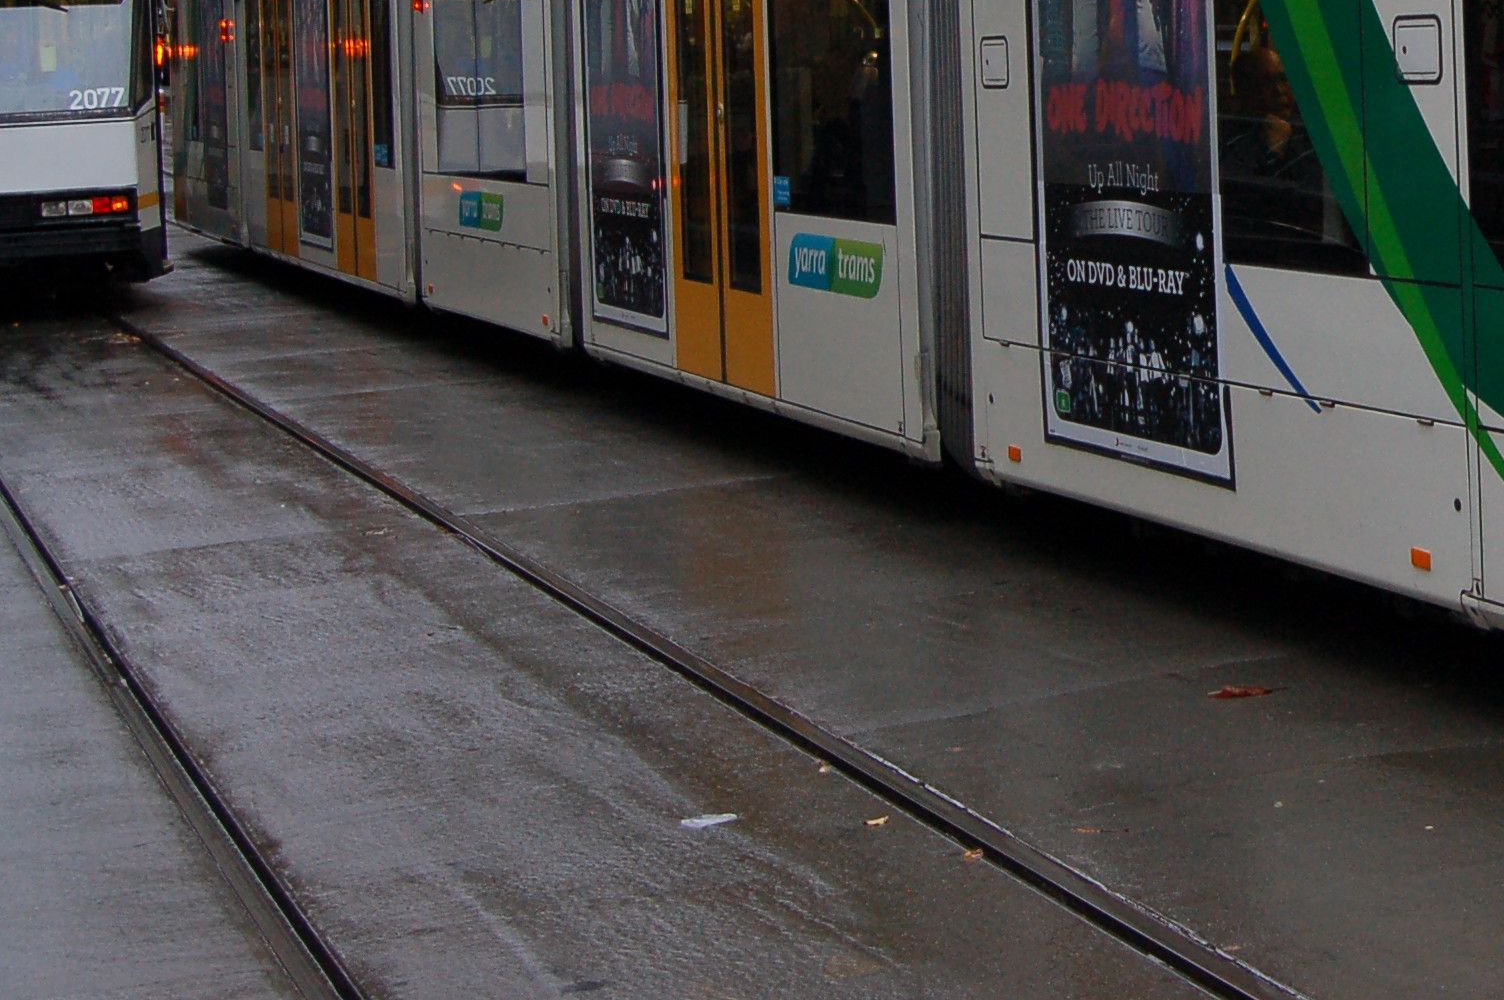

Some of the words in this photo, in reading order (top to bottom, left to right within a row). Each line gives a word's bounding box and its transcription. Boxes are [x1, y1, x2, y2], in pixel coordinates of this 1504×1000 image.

[69, 87, 125, 109] 2077
[1088, 164, 1104, 194] Up
[1107, 161, 1123, 187] All
[1126, 164, 1160, 196] Night
[1082, 208, 1105, 230] THE
[1107, 209, 1133, 230] LIVE
[1136, 211, 1169, 238] TOUR
[794, 246, 826, 279] yarra
[838, 247, 875, 284] trams
[1067, 259, 1086, 283] ON
[1088, 261, 1115, 286] DVD
[1117, 264, 1126, 287] &
